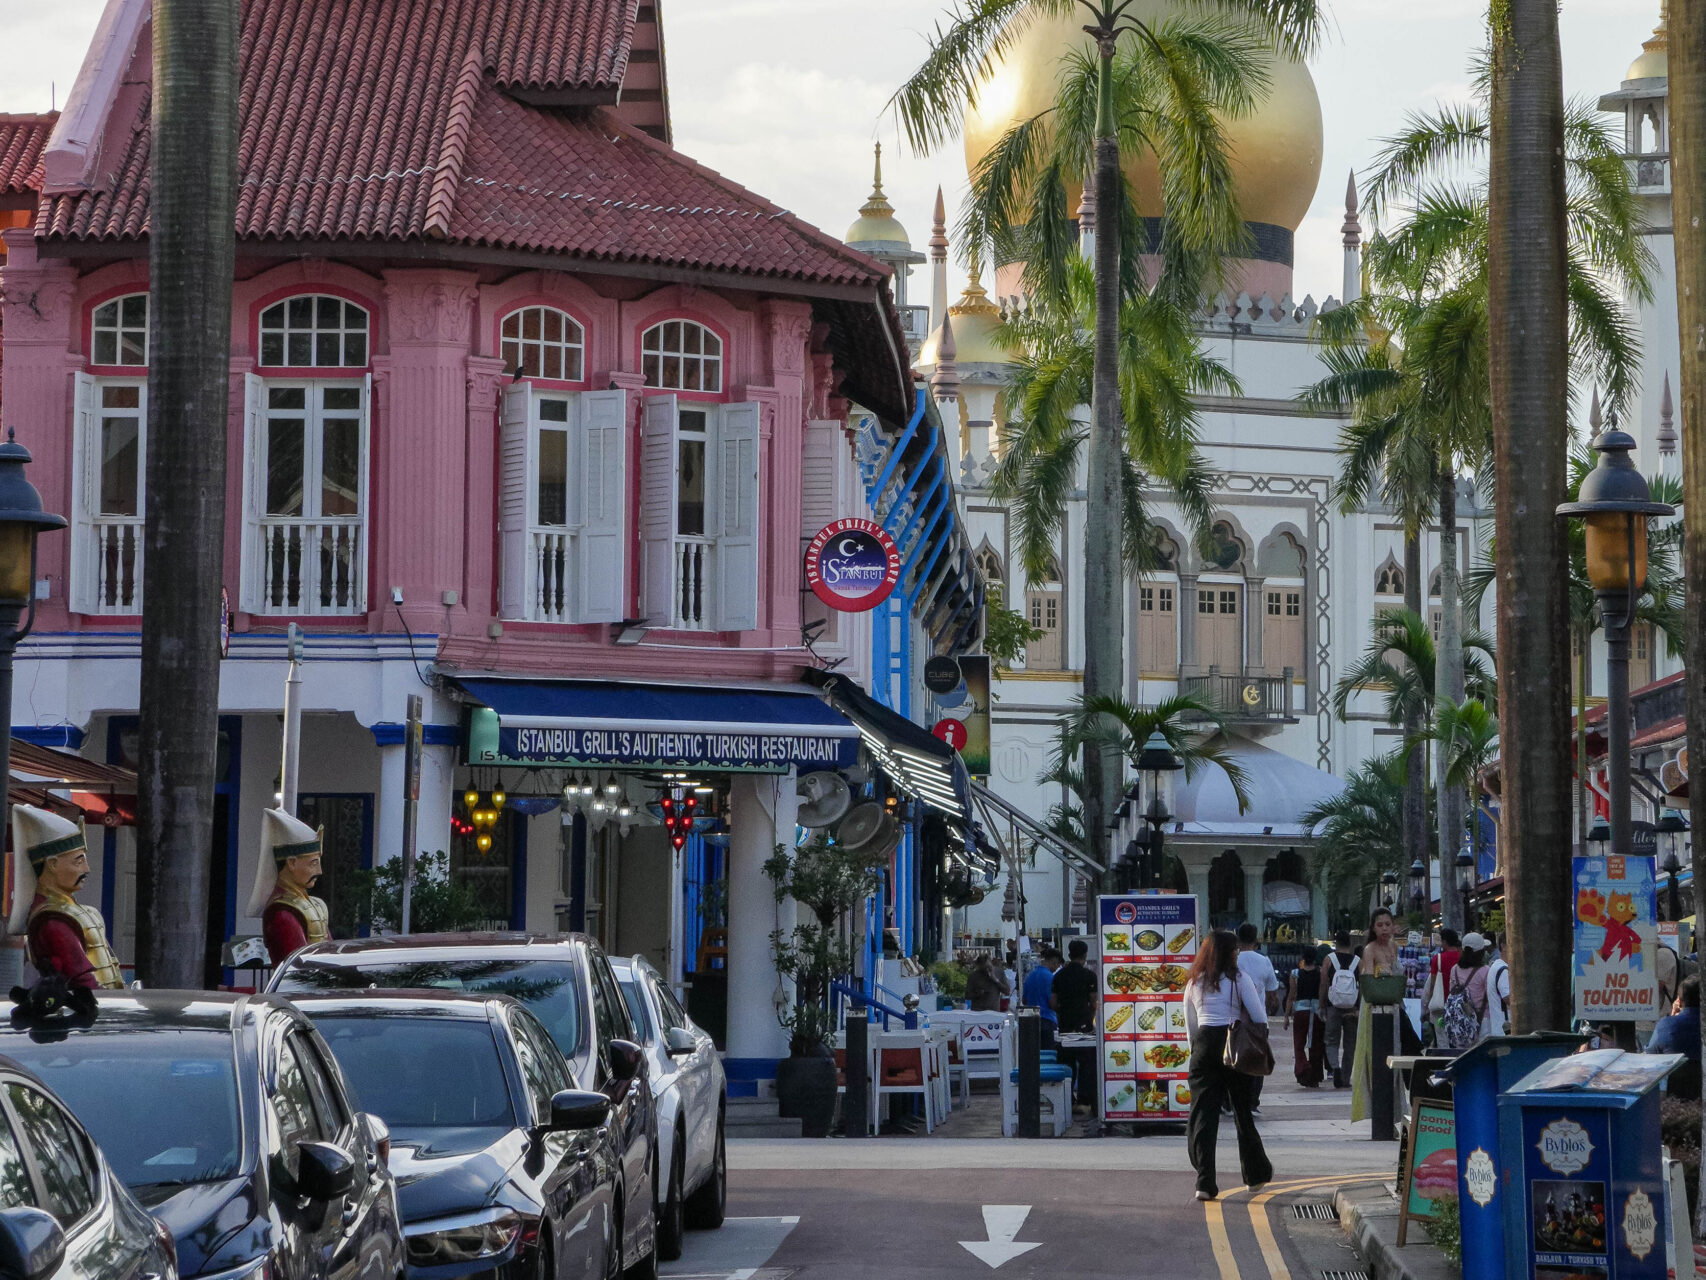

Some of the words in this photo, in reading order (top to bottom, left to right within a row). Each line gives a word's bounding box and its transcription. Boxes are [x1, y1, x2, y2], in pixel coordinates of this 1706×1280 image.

[837, 519, 886, 539] GRILL'S
[884, 541, 894, 549] &
[807, 527, 834, 584] ISTANBUL
[886, 553, 900, 584] CAFE
[517, 728, 580, 754] ISTANBUL
[582, 730, 631, 755] GRILL'S
[632, 732, 702, 758] AUTHENTIC
[705, 734, 758, 760] TURKISH
[761, 736, 841, 761] RESTAURANT
[1606, 973, 1628, 988] NO
[1583, 987, 1654, 1006] TOUTING!
[1420, 1115, 1455, 1125] come
[1420, 1125, 1452, 1135] good
[1535, 1254, 1562, 1263] BAKLAVA
[1568, 1255, 1594, 1265] TURKISH
[1595, 1256, 1608, 1265] TEA
